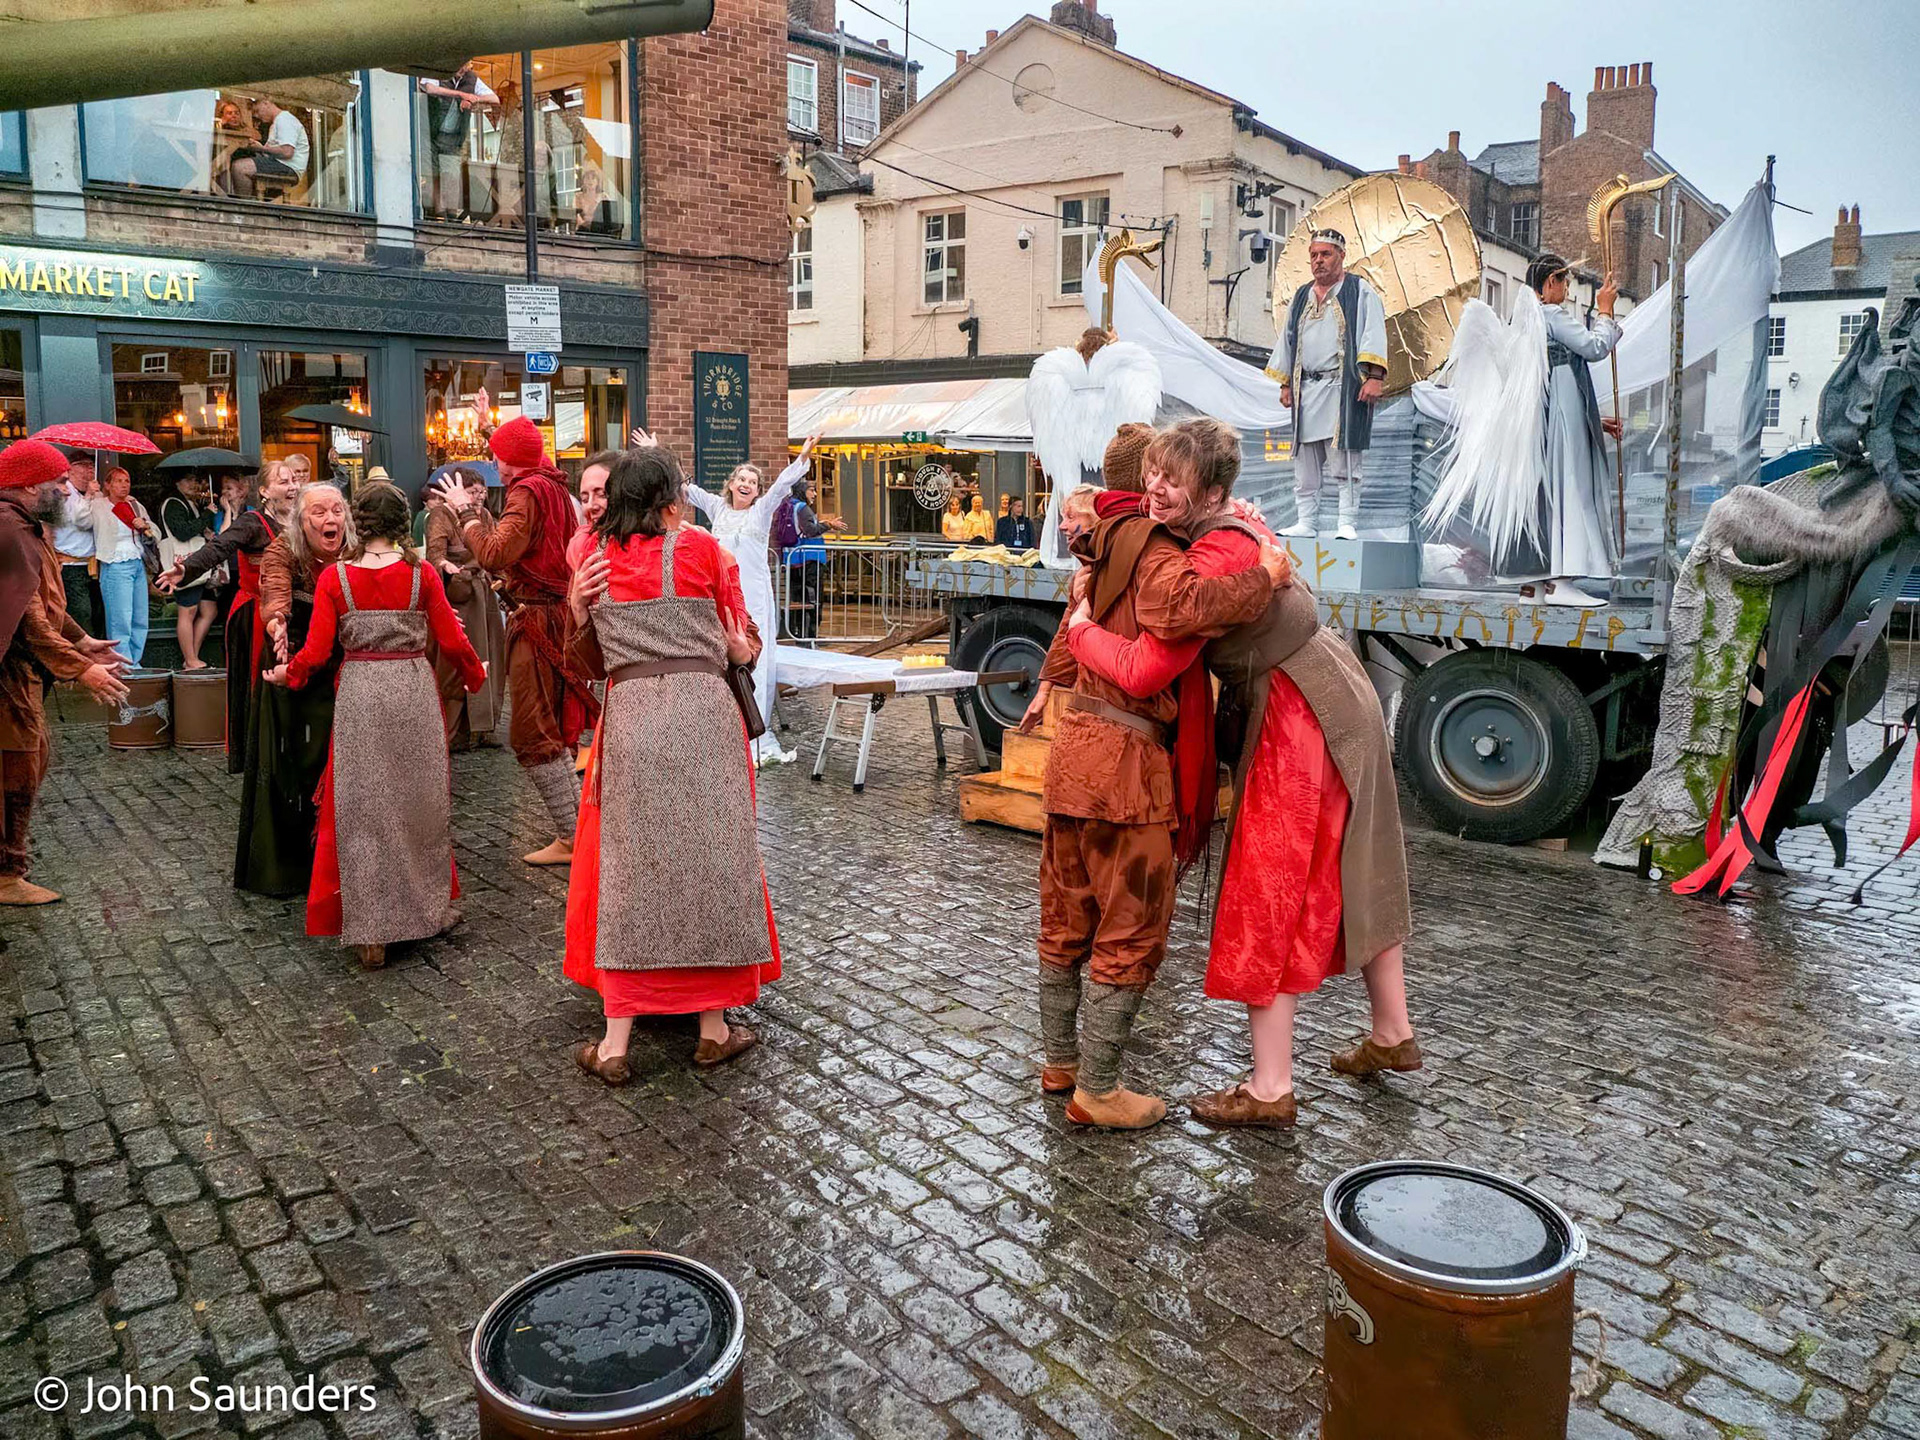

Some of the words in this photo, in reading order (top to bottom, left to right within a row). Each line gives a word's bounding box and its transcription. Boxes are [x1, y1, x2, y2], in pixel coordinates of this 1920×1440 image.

[0, 259, 134, 298] MARKET
[142, 269, 200, 302] CAT
[530, 316, 538, 324] M
[703, 364, 743, 398] THORNBRIDGE
[722, 401, 733, 411] CO
[916, 466, 935, 483] DOUGH
[930, 490, 949, 508] DOUGH
[1636, 495, 1666, 504] minste
